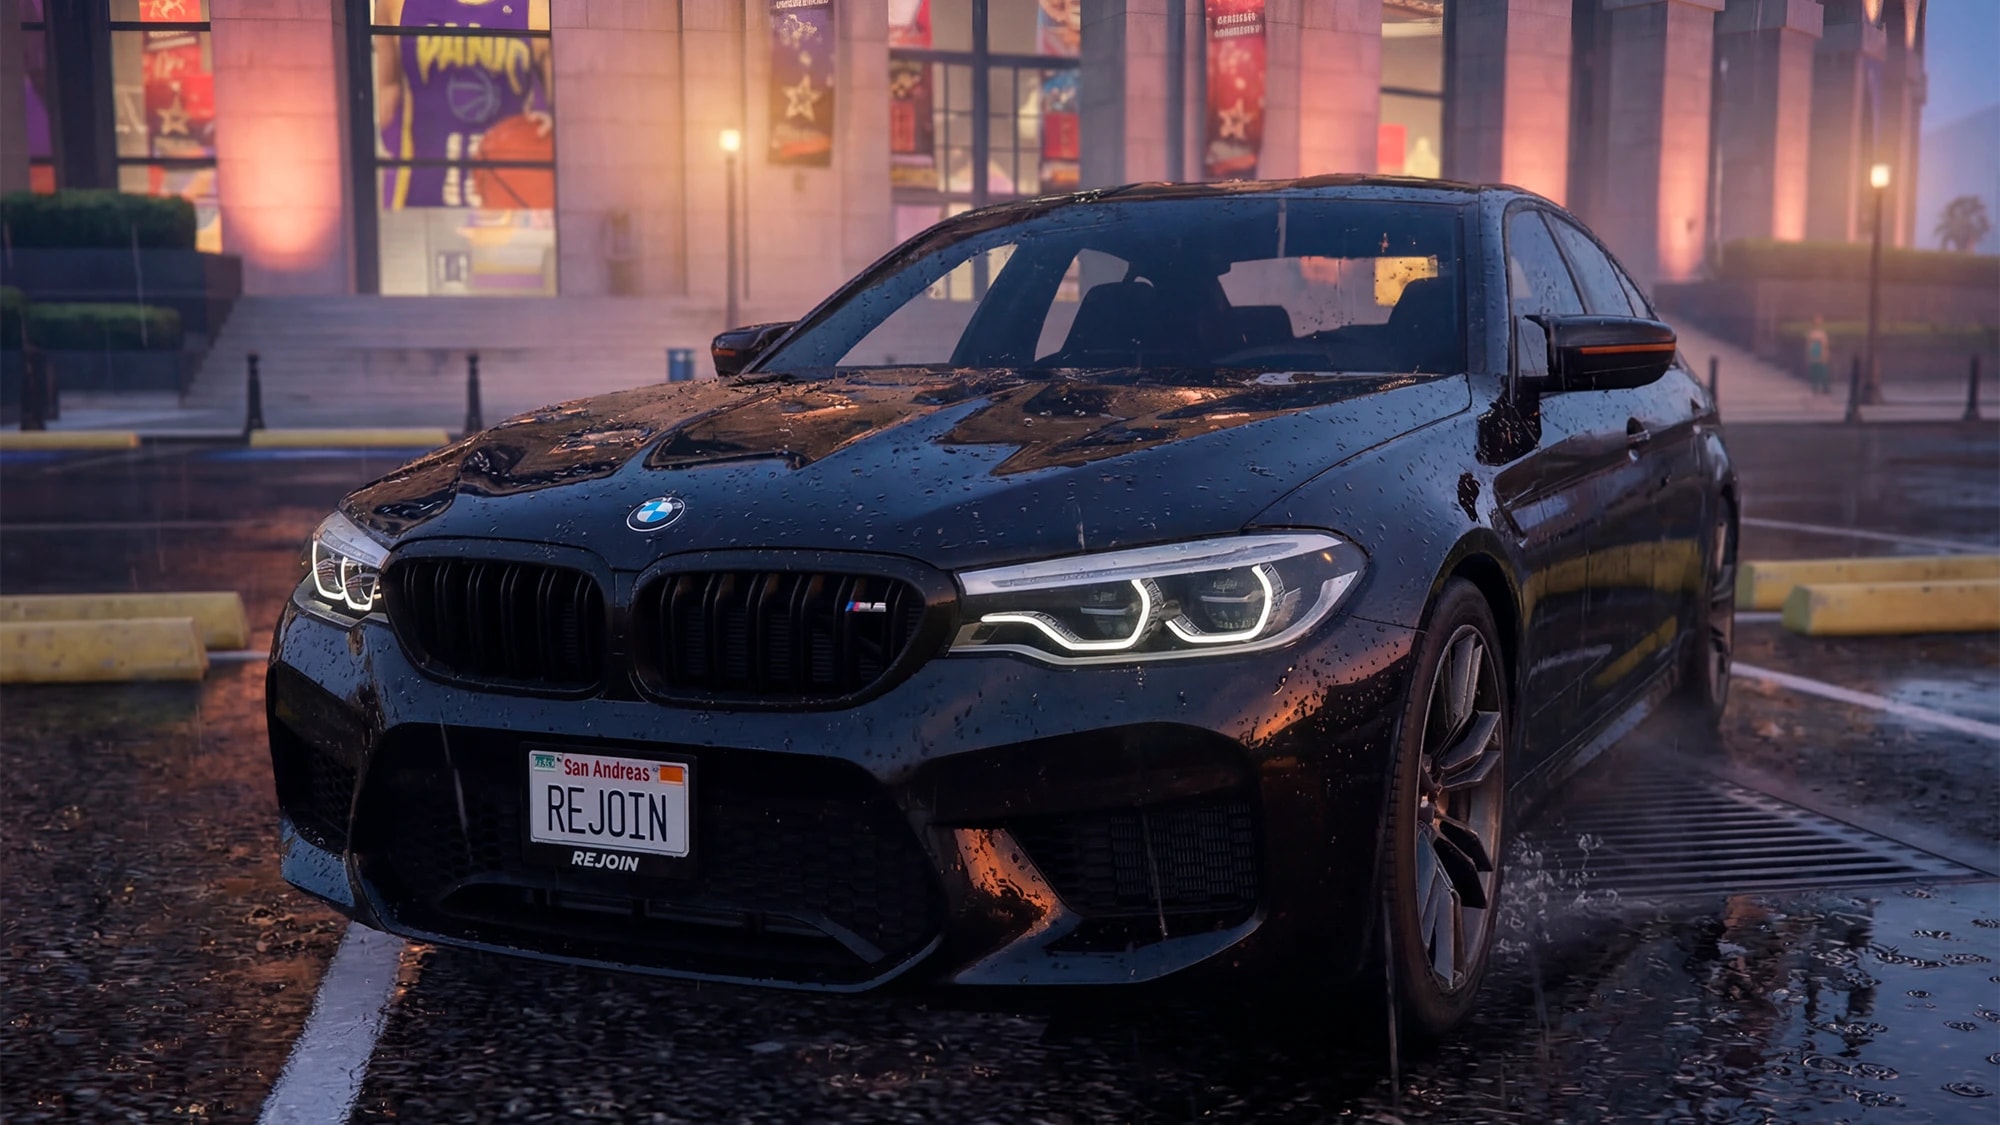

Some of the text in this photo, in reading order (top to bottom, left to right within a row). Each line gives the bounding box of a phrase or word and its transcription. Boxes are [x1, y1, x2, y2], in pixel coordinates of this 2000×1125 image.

[564, 758, 589, 777] San
[593, 760, 650, 782] Andreas
[548, 784, 668, 842] REJOIN
[571, 851, 639, 872] REJOIN
